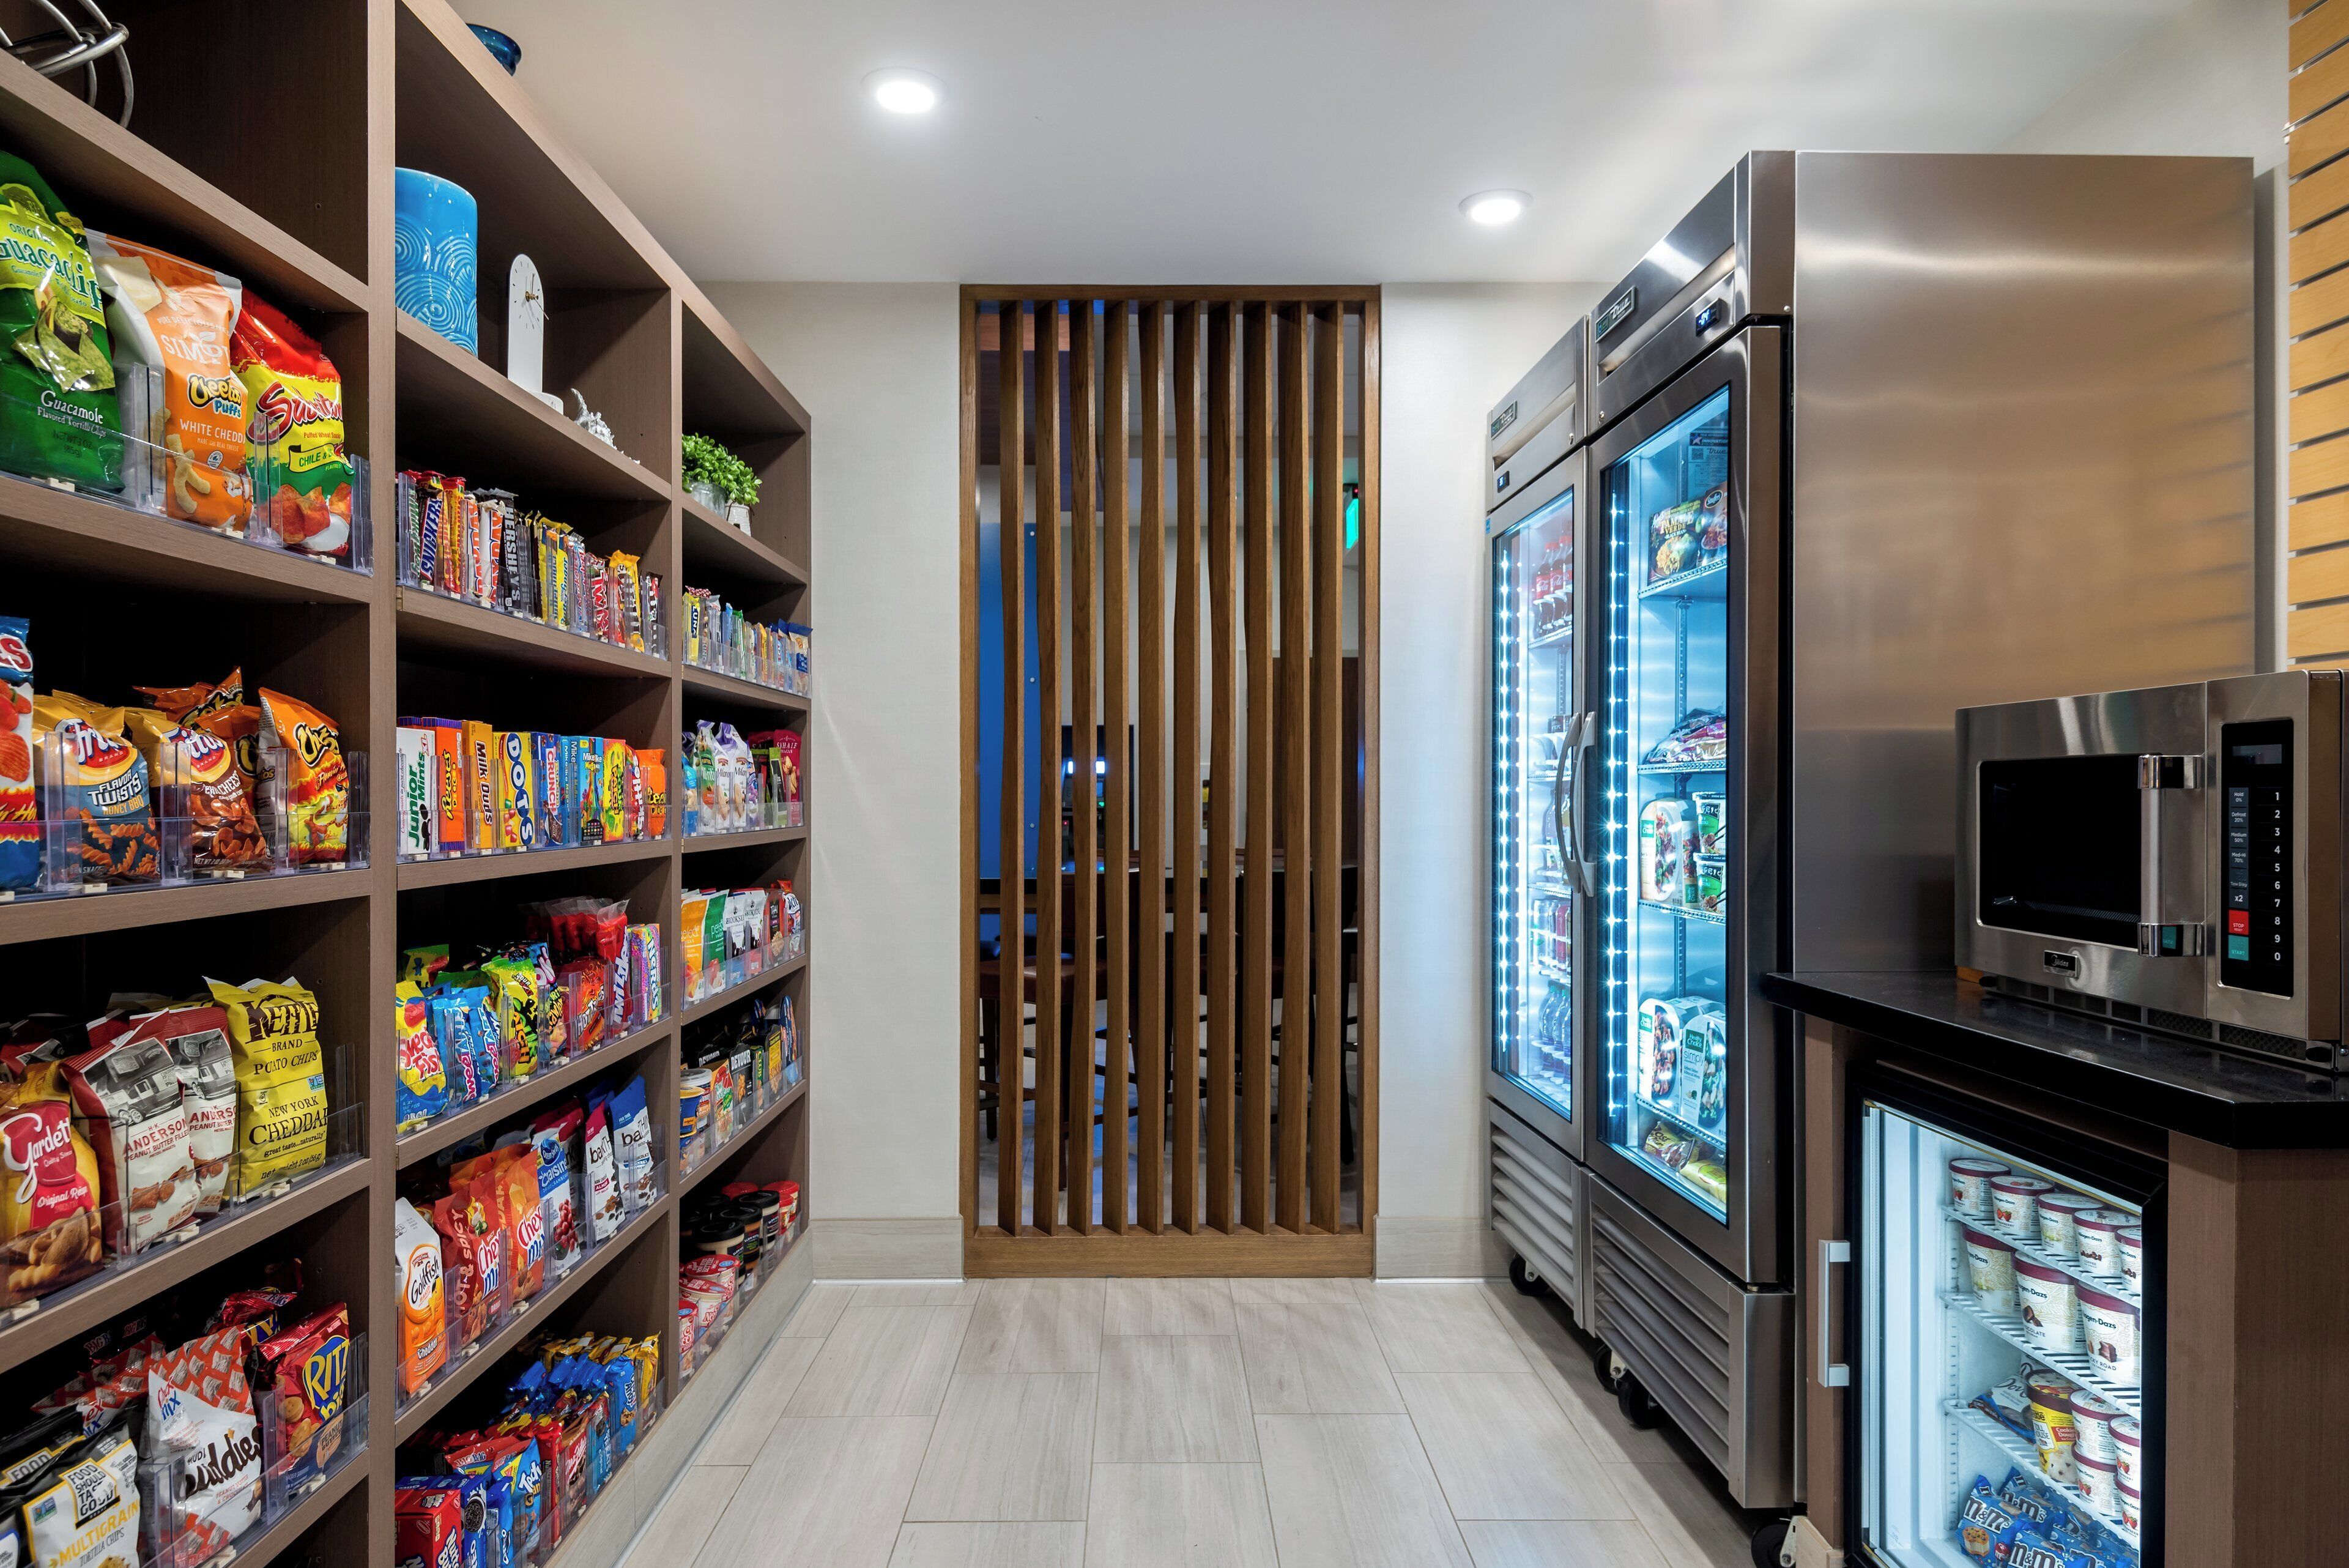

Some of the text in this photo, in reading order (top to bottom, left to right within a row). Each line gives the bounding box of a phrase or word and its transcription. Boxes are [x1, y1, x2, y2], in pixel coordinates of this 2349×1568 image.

[157, 316, 170, 325] PURE
[188, 374, 242, 407] Cheetos
[40, 390, 104, 424] Guacamole
[215, 399, 241, 418] Puffs
[37, 406, 106, 439] Flavored Tortilla Chips
[180, 418, 212, 437] WHITE
[299, 452, 321, 467] CHILE
[420, 499, 443, 582] SNICKERS
[1664, 524, 1687, 535] VERDE
[490, 509, 504, 604] PAYDAY
[505, 507, 521, 603] HERSHEY'S
[421, 734, 429, 756] XL
[98, 751, 124, 763] BRAND
[196, 756, 217, 768] BRAND
[583, 752, 595, 762] Mike
[98, 769, 132, 794] FLAVOR
[442, 749, 453, 820] Reese's
[507, 737, 533, 844] DOTS
[547, 750, 557, 814] CRUNCH
[103, 795, 144, 816] HONEY BBQ
[407, 765, 420, 848] Junior
[517, 973, 531, 986] SOUR
[272, 1039, 303, 1052] BRAND
[1687, 1038, 1702, 1049] Choice
[1689, 1033, 1702, 1042] Healthy
[291, 1050, 318, 1067] CHIPS
[731, 1049, 751, 1071] DEVOUR
[1683, 1050, 1704, 1067] simply
[268, 1096, 319, 1118] NEW YORK
[190, 1122, 217, 1131] PEANUT
[124, 1140, 174, 1162] PEANUT BUTTER
[264, 1144, 281, 1158] great
[542, 1150, 551, 1163] Ocean
[261, 1167, 276, 1180] net
[37, 1191, 69, 1209] Original
[451, 1208, 473, 1260] SPICY
[518, 1208, 543, 1248] Chex
[478, 1228, 500, 1273] Chex
[412, 1255, 440, 1305] Goldfish
[266, 1293, 288, 1306] BAG
[419, 1285, 431, 1303] BAKED
[417, 1338, 437, 1361] Cheddar
[2099, 1362, 2117, 1371] ROAD
[158, 1376, 175, 1408] Chex
[321, 1420, 343, 1446] PEANUT
[322, 1430, 342, 1452] BUTTER
[11, 1454, 50, 1481] FOOD
[453, 1452, 486, 1467] BIG BAG
[68, 1464, 98, 1485] FOOD
[75, 1472, 106, 1493] SHOULD
[216, 1475, 249, 1498] PEANUT BUTTER
[1963, 1496, 2012, 1534] m&m's
[59, 1499, 140, 1566] MULTIGRAIN
[80, 1527, 124, 1567] TORTILLA CHIPS
